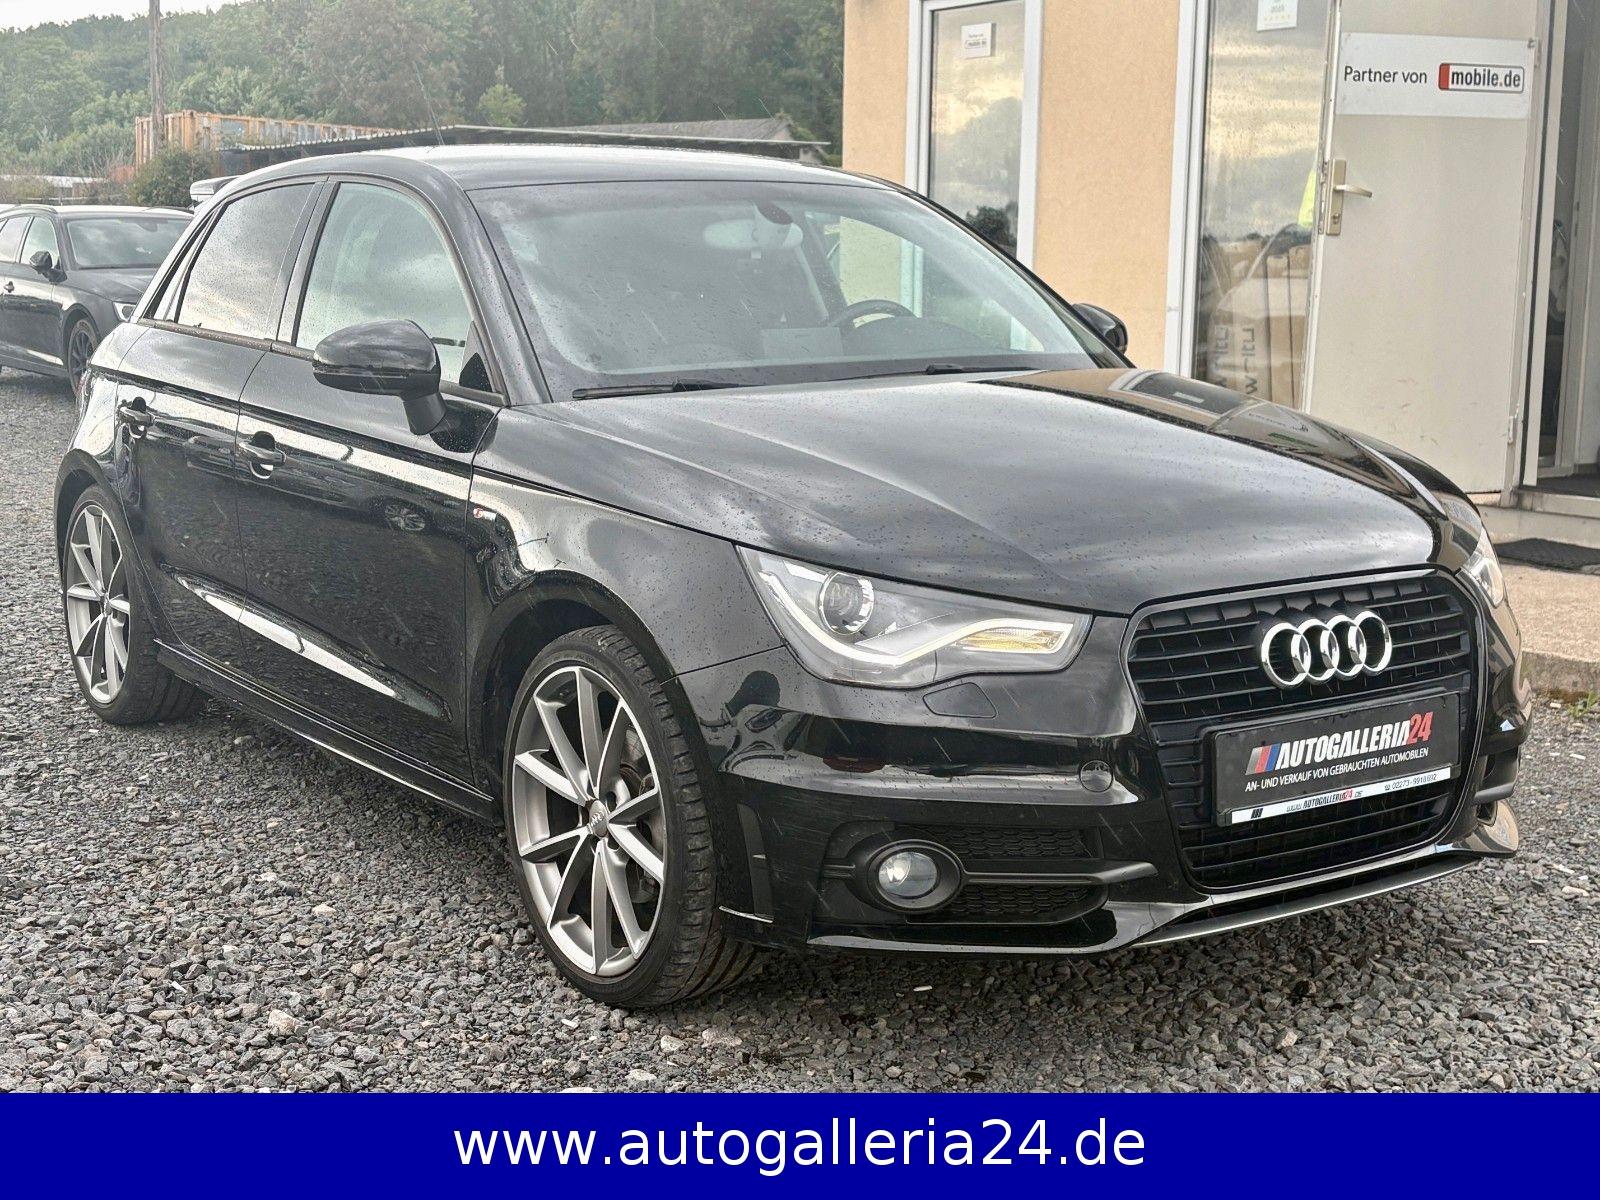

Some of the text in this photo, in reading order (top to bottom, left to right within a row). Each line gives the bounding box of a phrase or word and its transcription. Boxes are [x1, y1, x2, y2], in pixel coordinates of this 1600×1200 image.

[1344, 66, 1521, 88] Partner von mobile.de
[1275, 711, 1434, 771] AUTOGALLERIA24
[1245, 747, 1430, 792] AN- UND VERKAUF VON GEBRAUCHTEN AUTOMOBILEN
